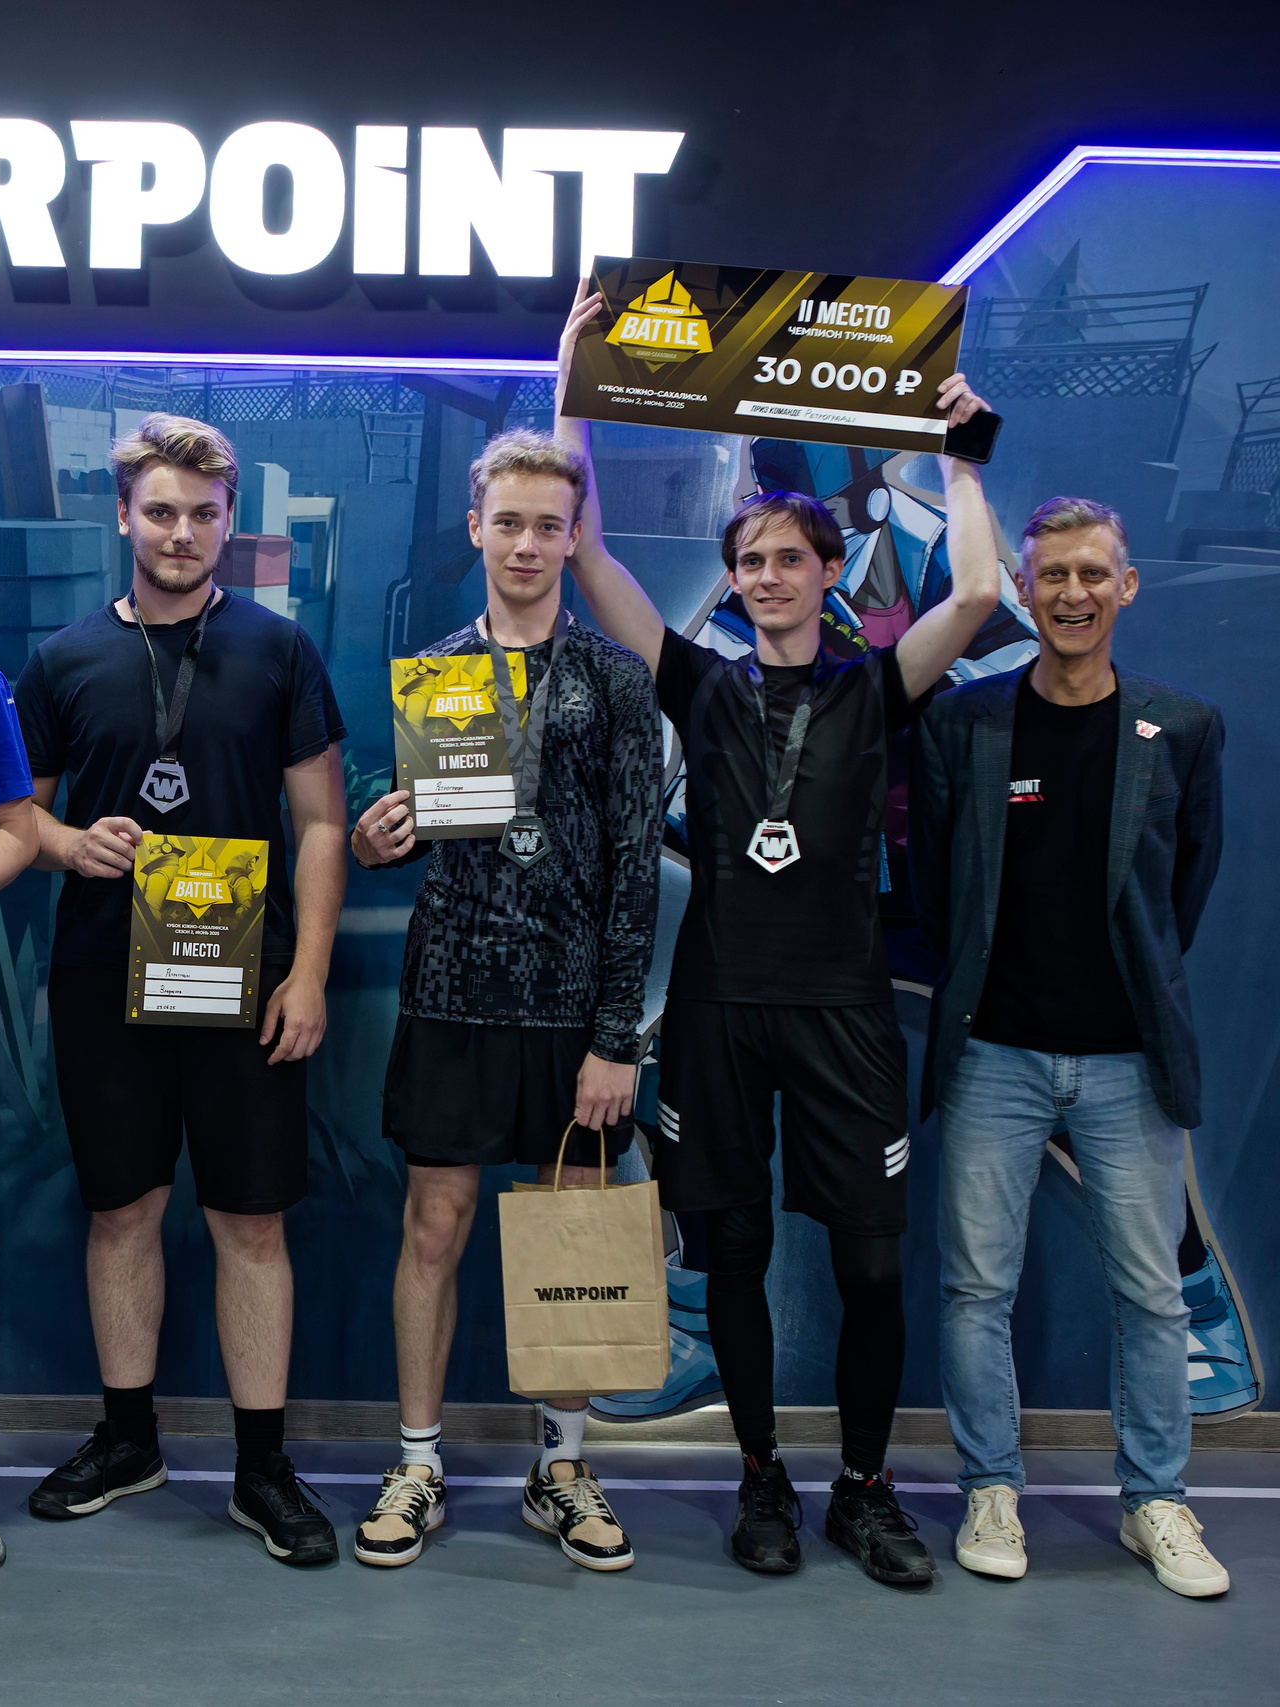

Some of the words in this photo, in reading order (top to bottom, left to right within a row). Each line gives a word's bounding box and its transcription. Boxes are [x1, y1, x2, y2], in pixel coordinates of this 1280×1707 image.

[646, 305, 686, 315] WARPOINT
[817, 301, 891, 330] МЕСТО
[619, 316, 700, 346] BATTLE
[788, 326, 843, 340] ЧЕМПИОН
[844, 331, 894, 344] ТУРНИРА
[753, 355, 802, 386] 30
[810, 361, 887, 394] 000
[597, 384, 625, 393] КУБОК
[664, 401, 685, 410] 2025
[750, 404, 769, 415] ПРИЗ
[769, 406, 803, 417] КОМАНДЕ
[435, 694, 485, 713] BATTLE
[449, 753, 489, 770] МЕСТО
[174, 880, 224, 900] BATTLE
[182, 942, 220, 958] МЕСТО
[534, 1286, 629, 1301] WARPOINT
